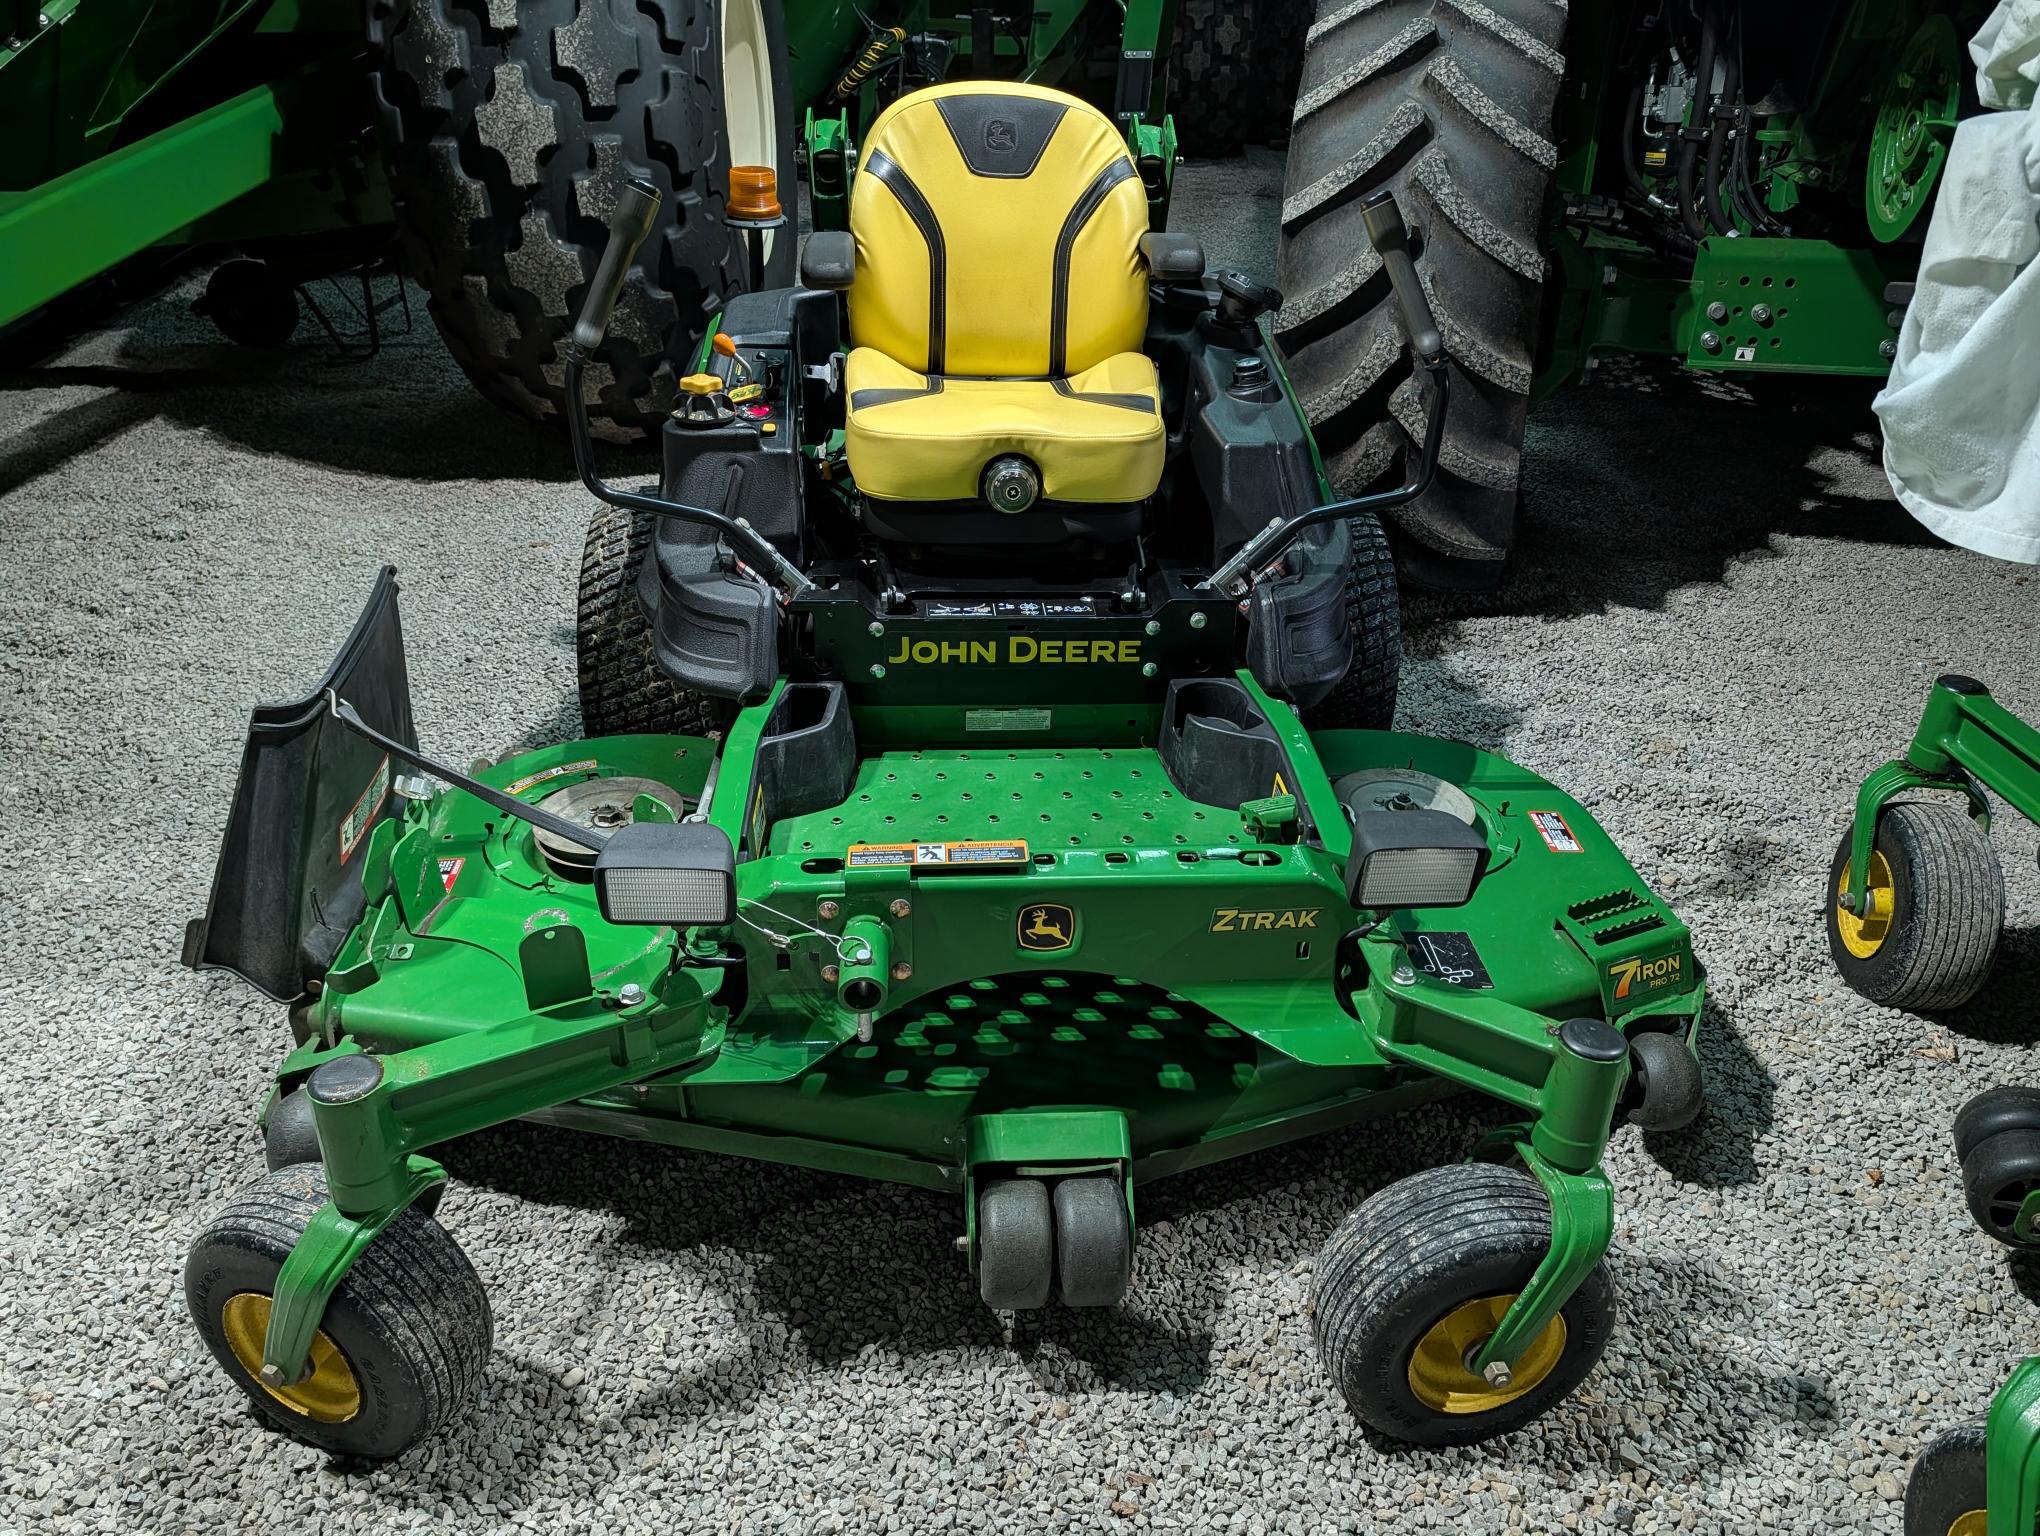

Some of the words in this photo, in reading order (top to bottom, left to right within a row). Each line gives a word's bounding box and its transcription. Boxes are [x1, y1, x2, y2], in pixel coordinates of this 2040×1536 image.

[888, 636, 997, 664] JOHN
[1008, 636, 1142, 663] DEERE
[1212, 909, 1320, 932] ZTRAK
[1650, 978, 1668, 988] PRO
[1670, 973, 1680, 983] 72
